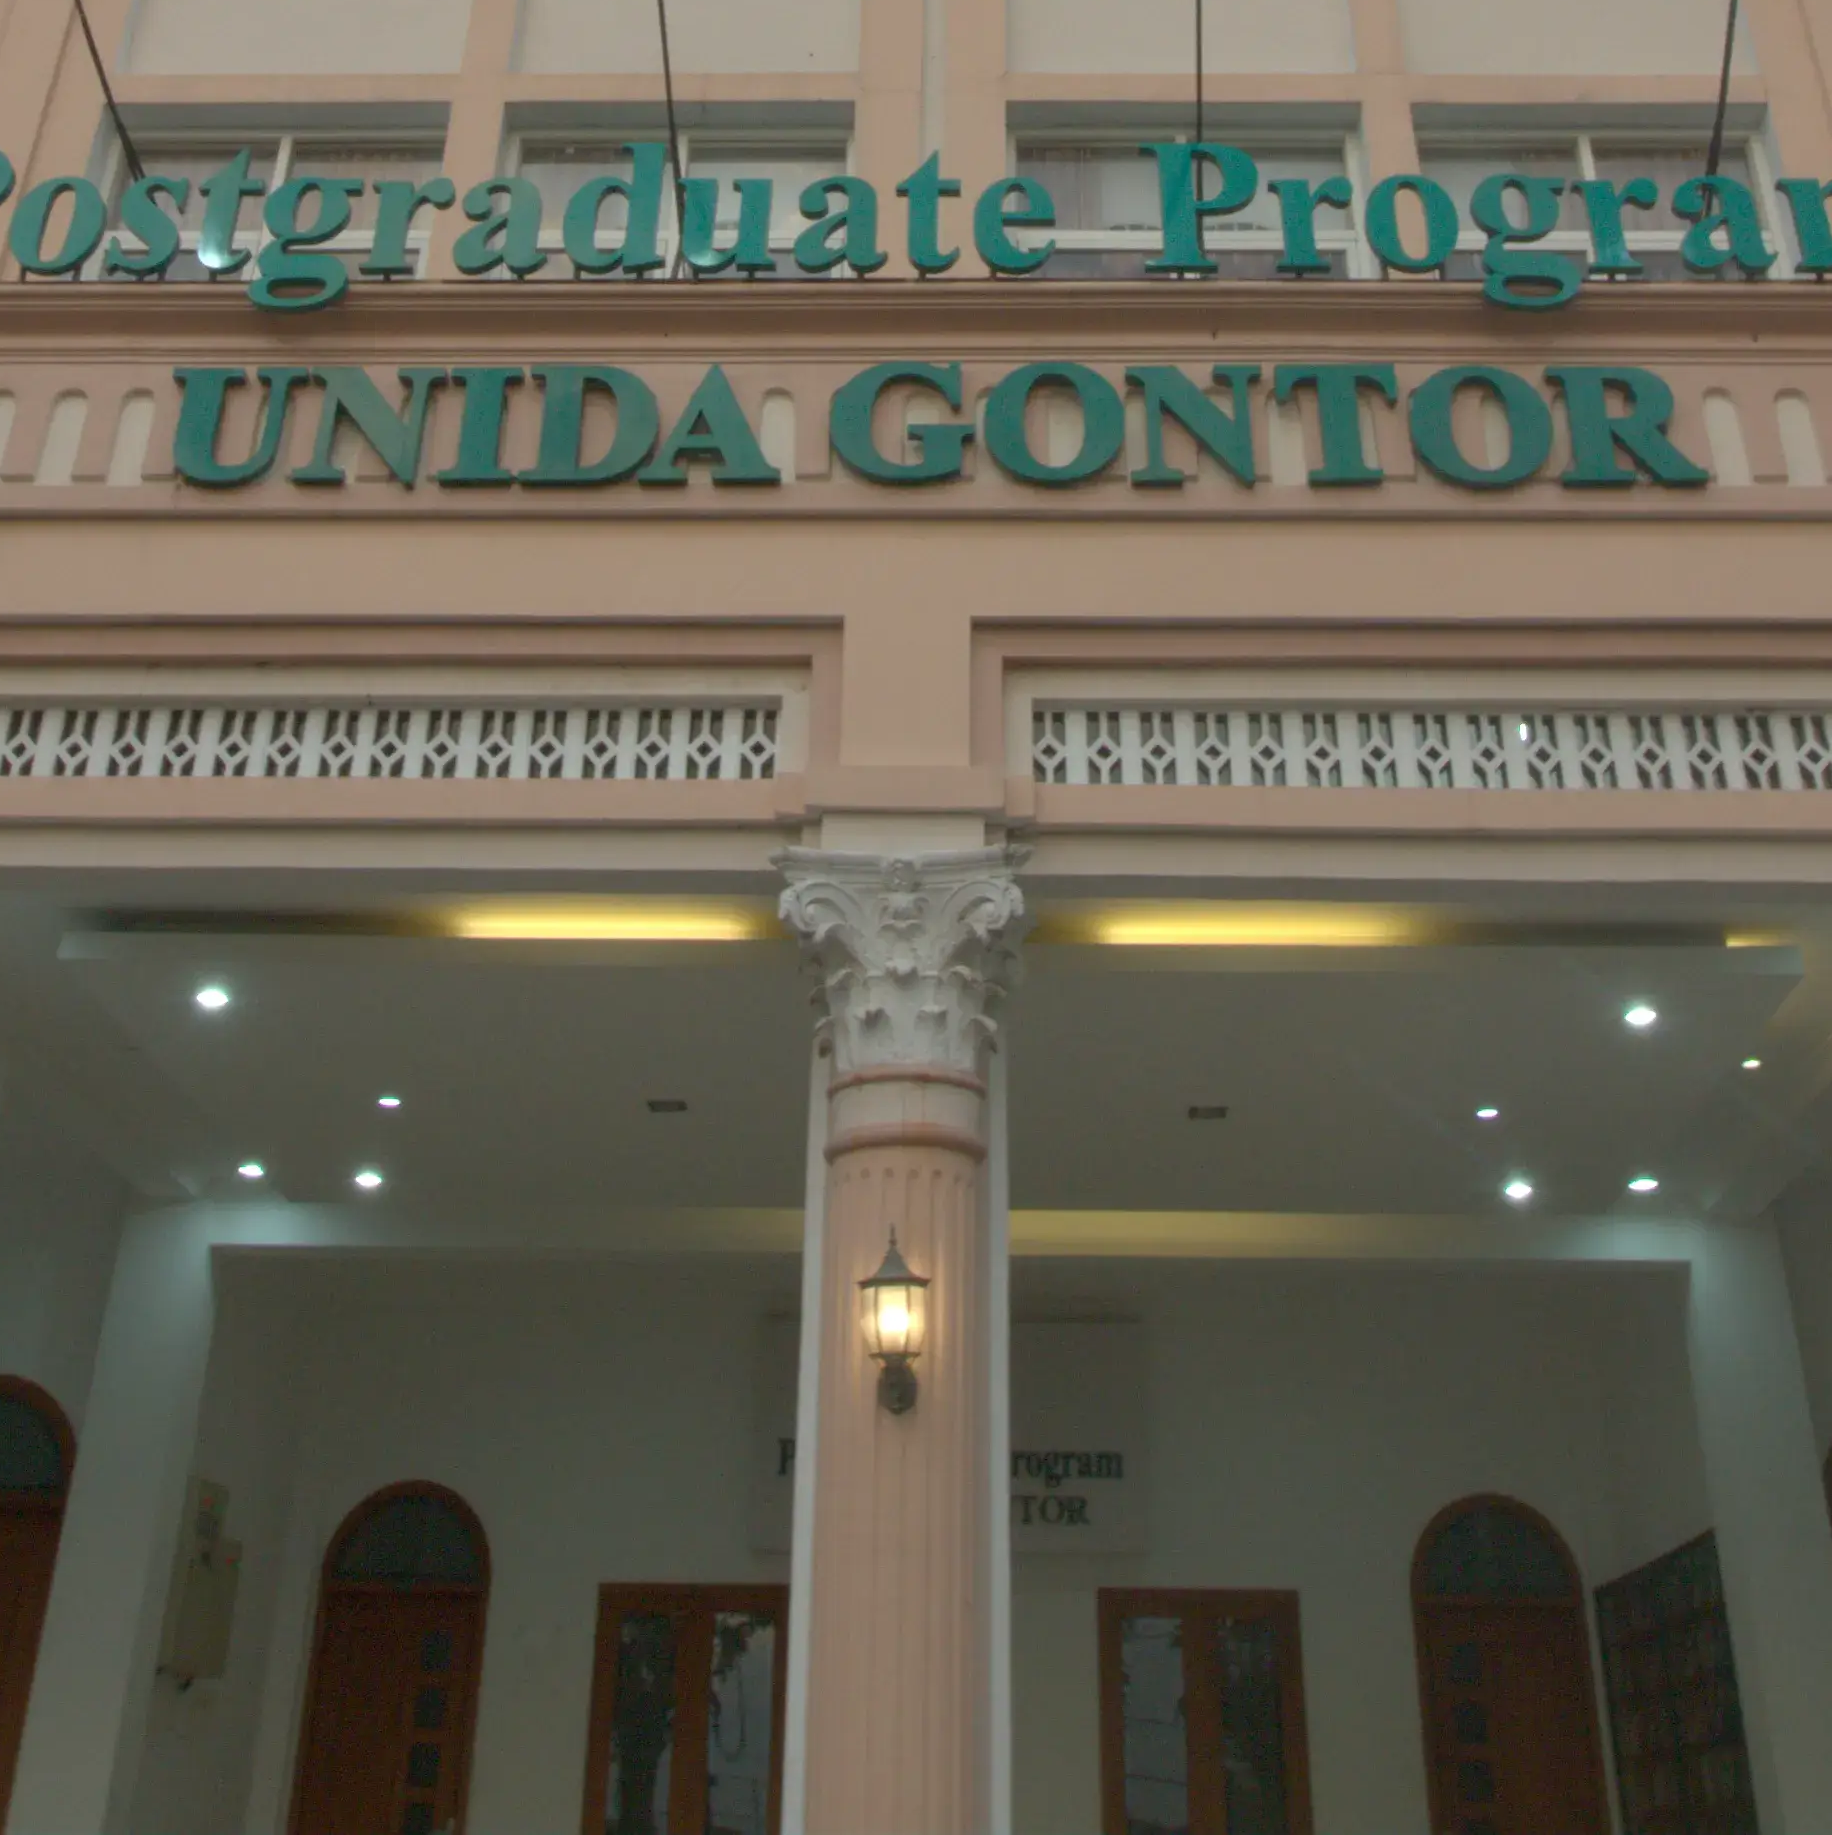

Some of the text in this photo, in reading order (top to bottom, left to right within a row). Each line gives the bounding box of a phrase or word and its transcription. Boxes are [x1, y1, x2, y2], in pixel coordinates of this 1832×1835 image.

[173, 360, 1709, 490] UNIDA GONTOR
[1010, 1450, 1124, 1489] rogram
[1011, 1494, 1091, 1525] TOR
